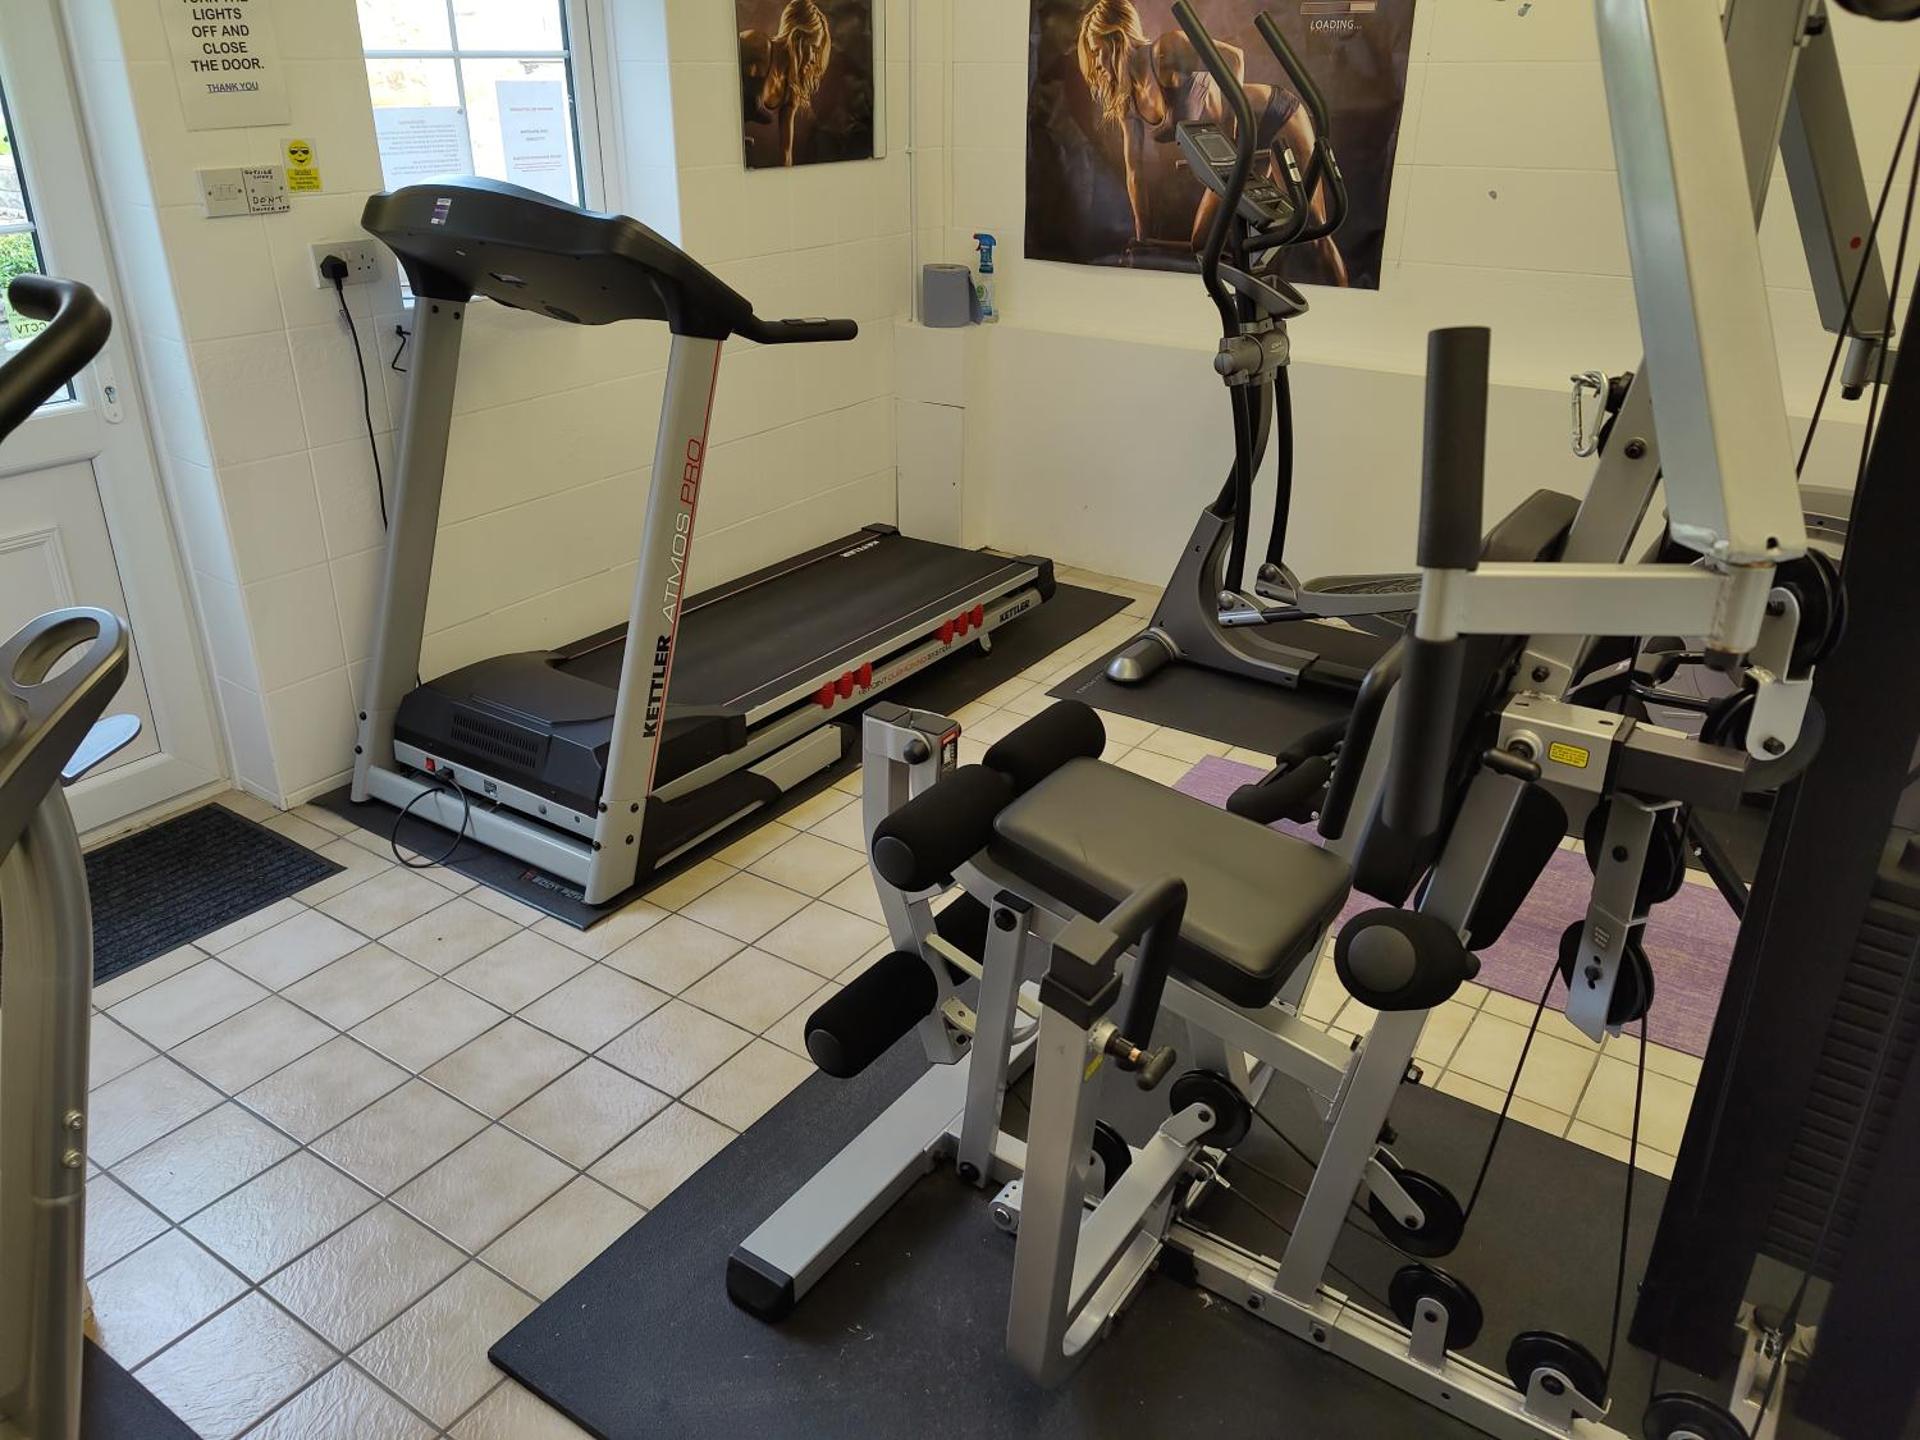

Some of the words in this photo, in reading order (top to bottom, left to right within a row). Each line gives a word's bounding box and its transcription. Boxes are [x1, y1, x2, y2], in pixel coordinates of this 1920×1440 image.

[193, 8, 242, 20] LIGHTS
[192, 25, 217, 38] OFF
[222, 24, 249, 37] AND
[1310, 19, 1362, 31] LOADING...
[202, 41, 248, 55] CLOSE
[190, 60, 219, 72] THE
[221, 58, 265, 71] DOOR.
[206, 83, 239, 93] THANK
[239, 81, 259, 92] YOU
[642, 634, 672, 738] KETTLER
[662, 512, 691, 625] ATMOS
[680, 438, 702, 506] PRO
[999, 600, 1031, 623] KETTLER
